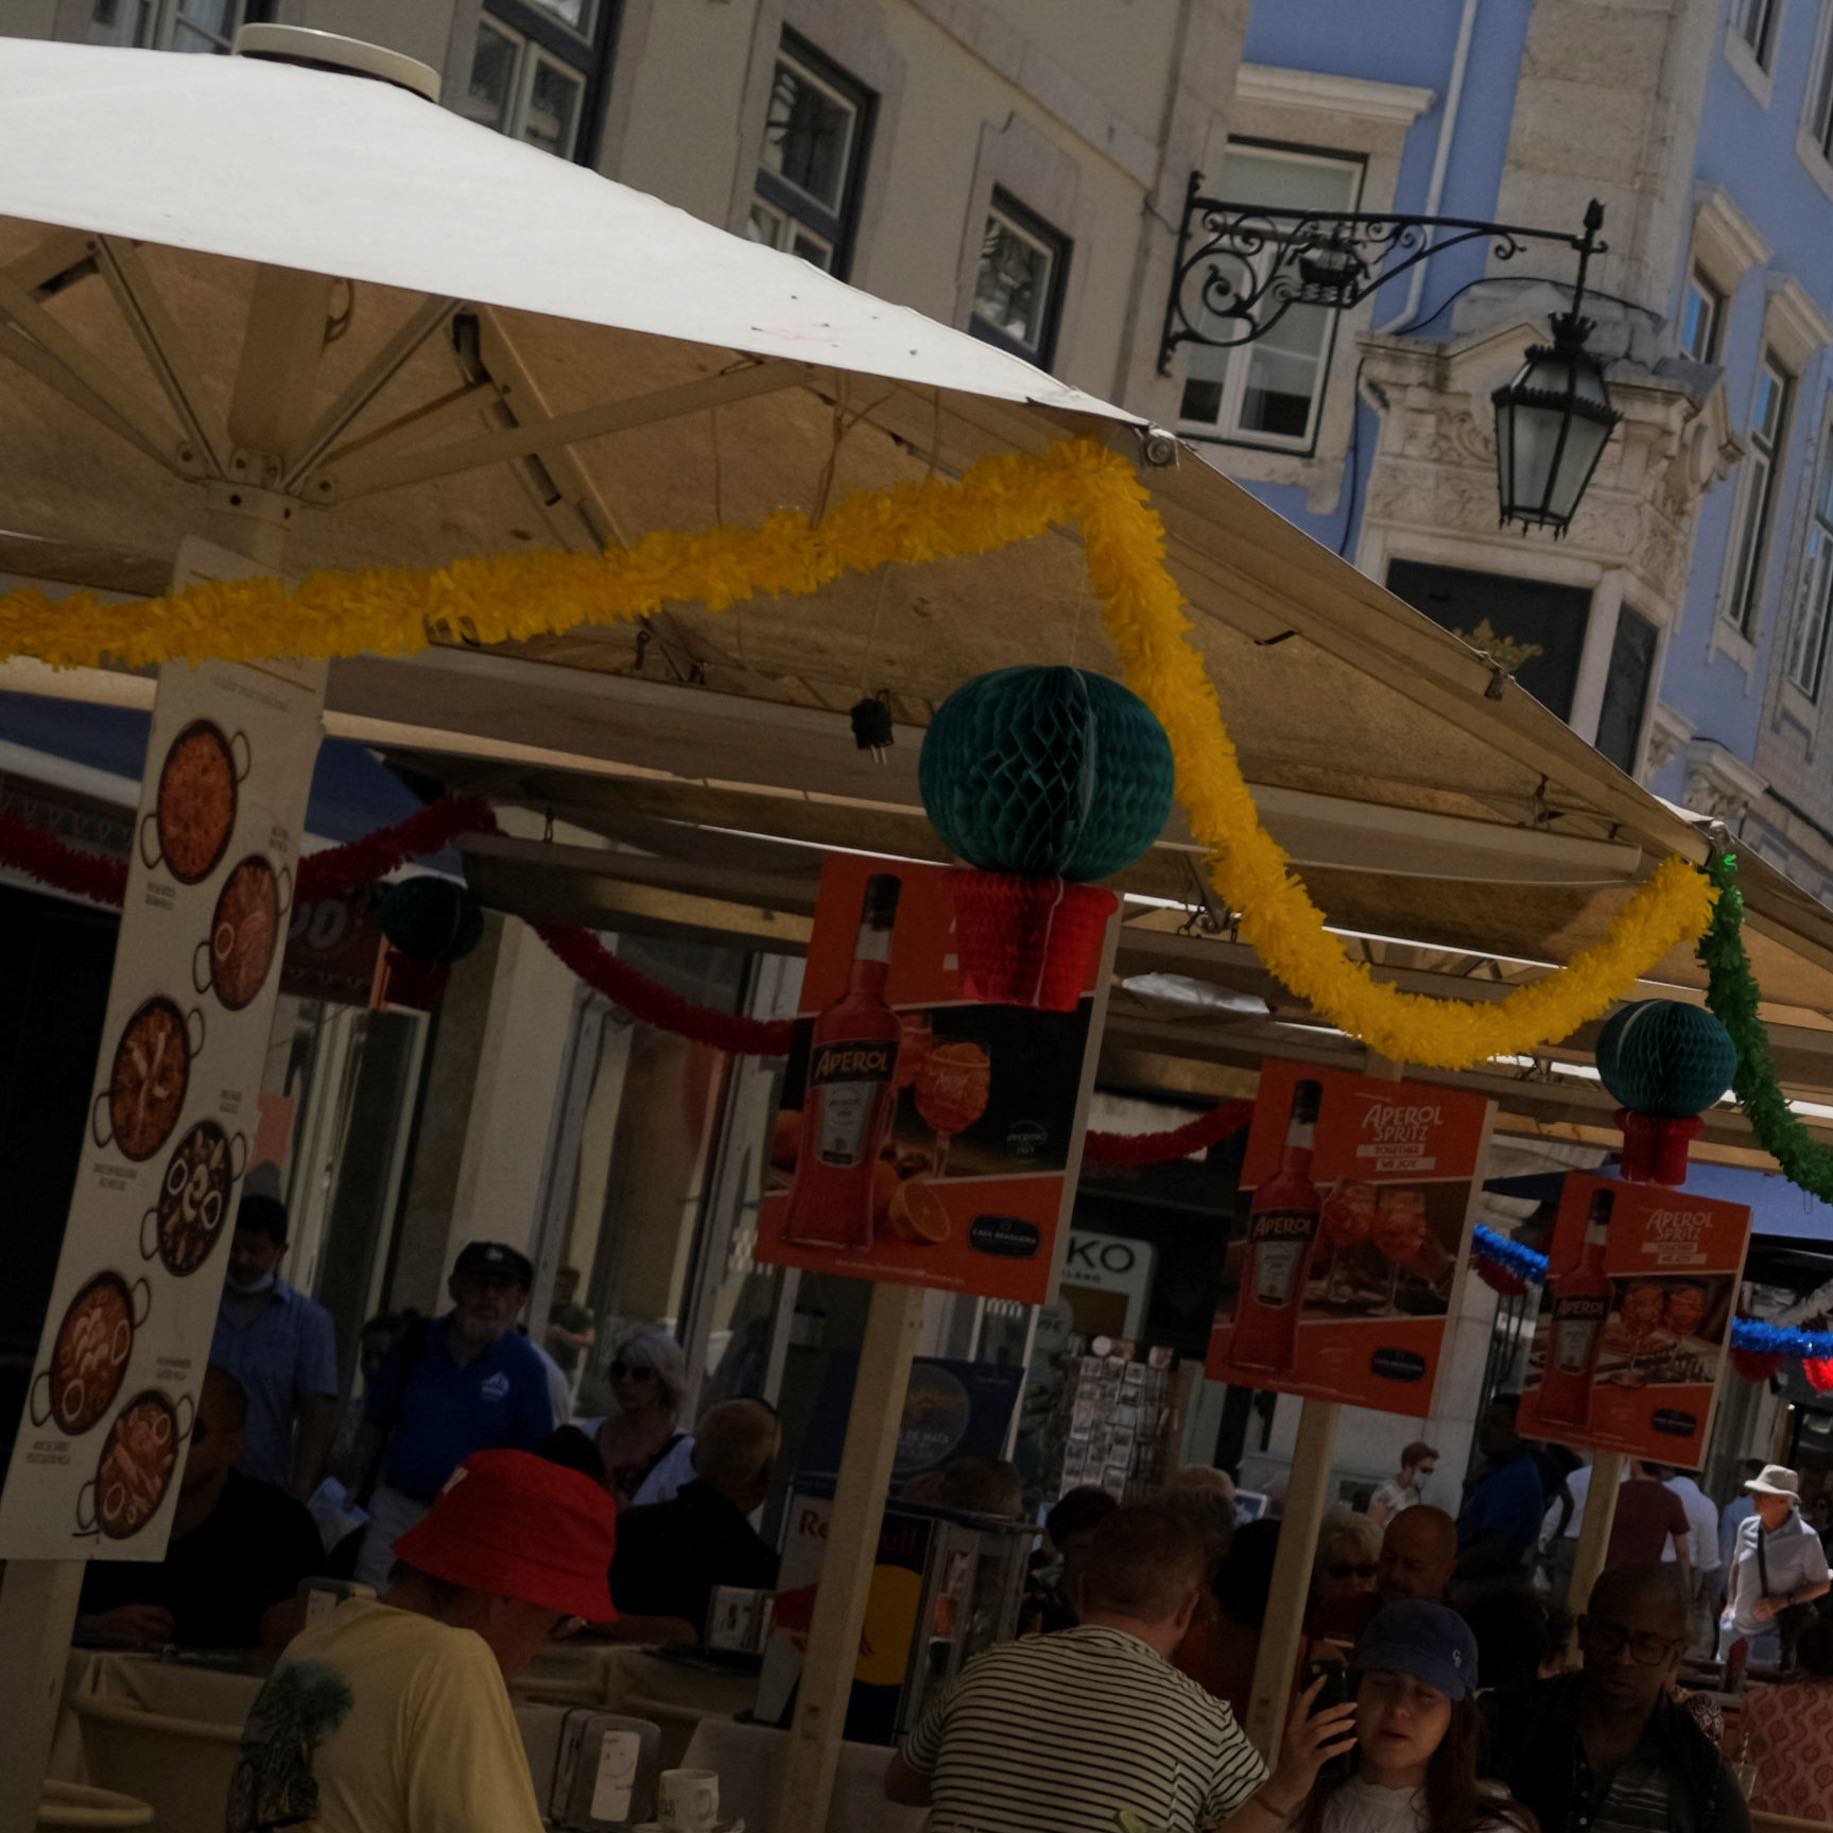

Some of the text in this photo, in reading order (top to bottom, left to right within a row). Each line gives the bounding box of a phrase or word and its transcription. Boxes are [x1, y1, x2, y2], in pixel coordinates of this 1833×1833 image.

[816, 1048, 889, 1077] APEROL
[1362, 1104, 1444, 1128] APEROL
[1373, 1124, 1430, 1142] SPRITZ
[1254, 1217, 1312, 1237] APEROL
[1646, 1208, 1714, 1232] APEROL
